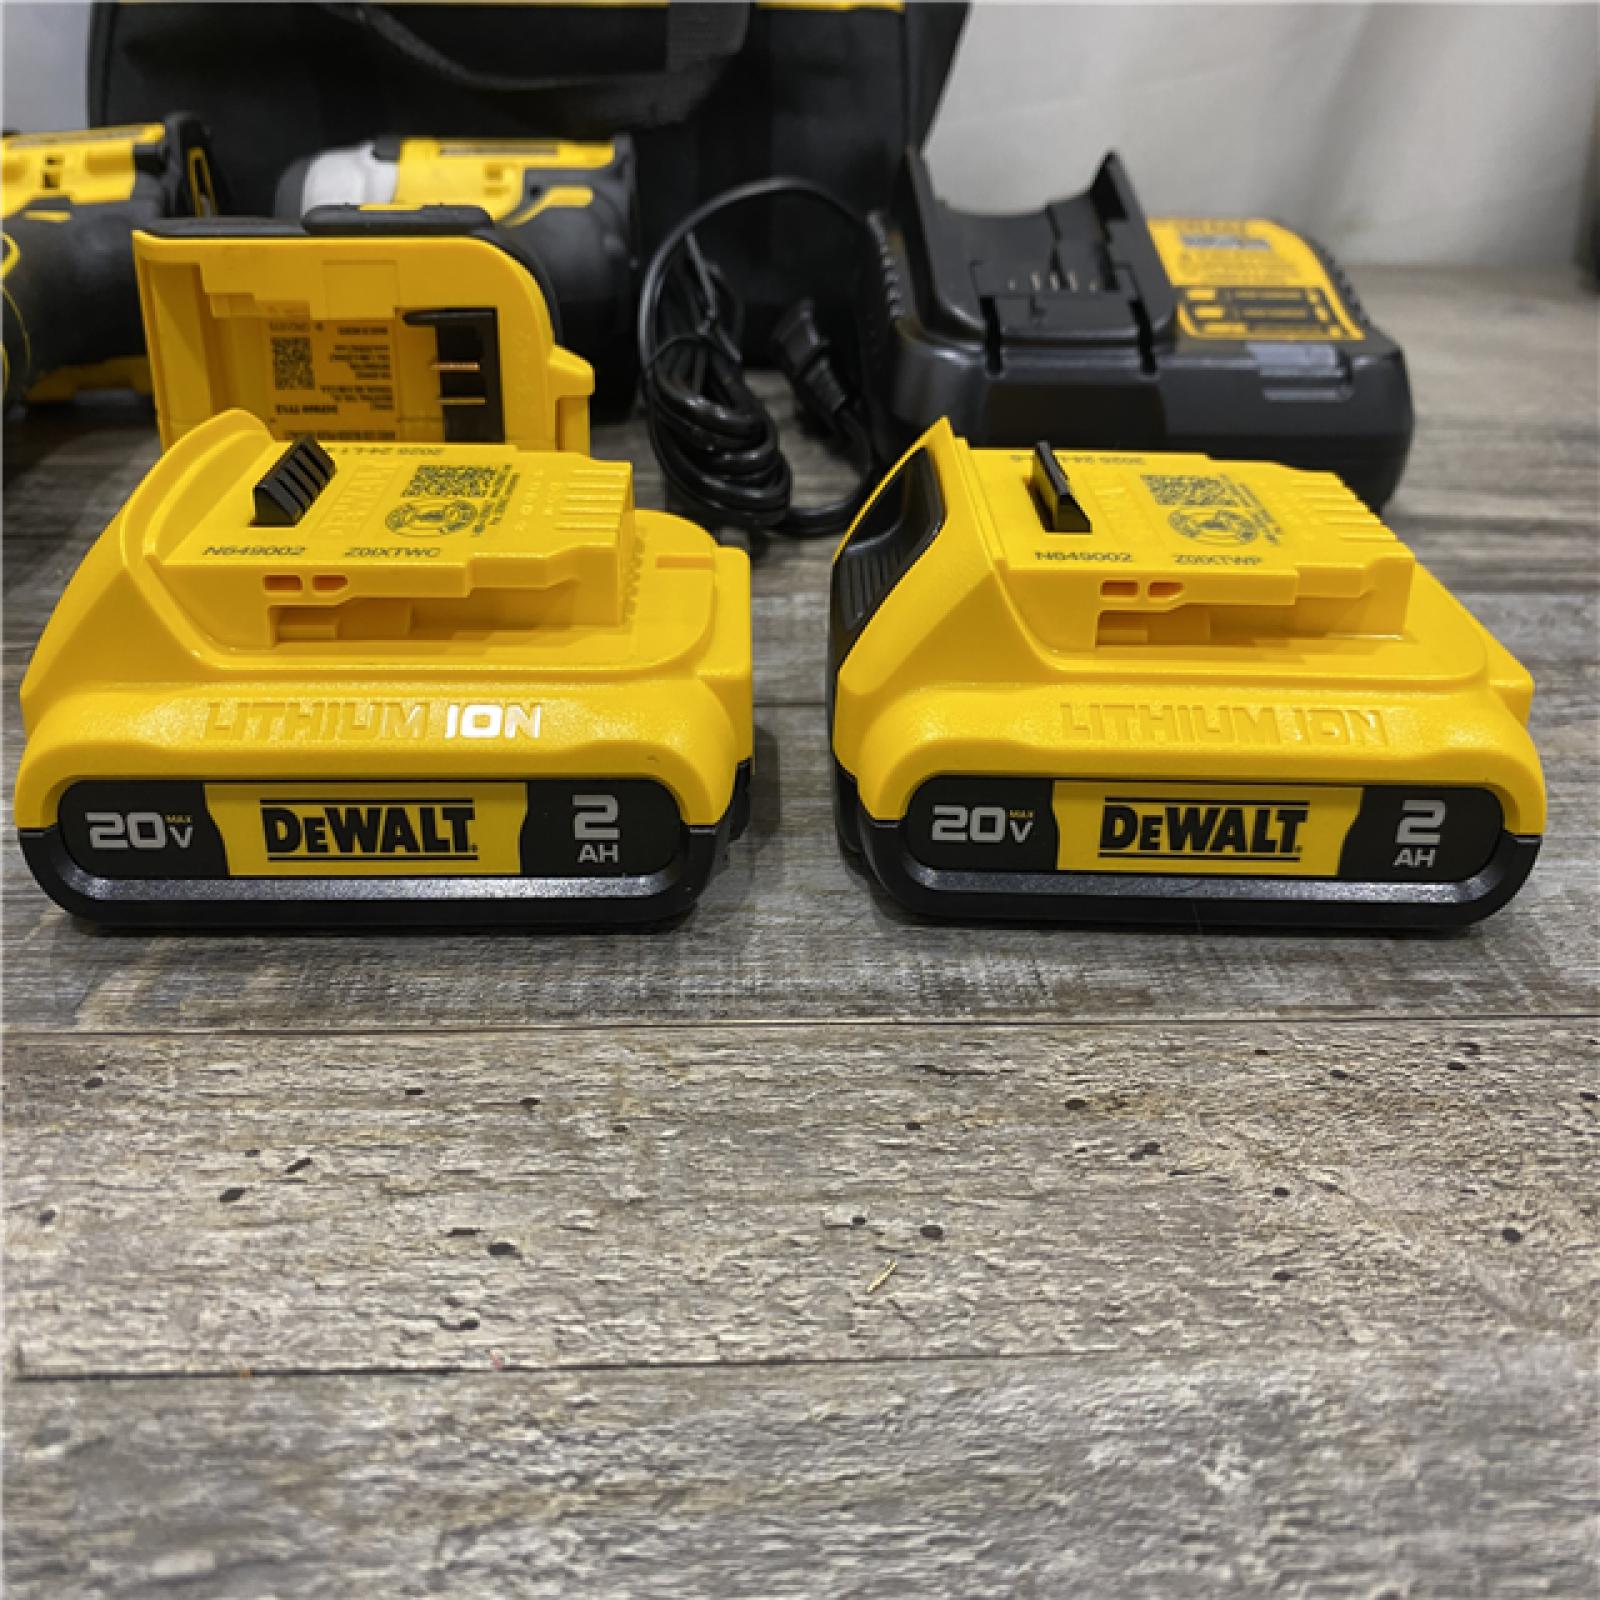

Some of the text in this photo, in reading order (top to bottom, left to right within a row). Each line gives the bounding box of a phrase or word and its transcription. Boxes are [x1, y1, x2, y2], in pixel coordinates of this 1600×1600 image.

[204, 702, 543, 740] LITHIUM ION
[1059, 703, 1389, 747] LITHIUM ION
[572, 794, 621, 841] 2
[1395, 799, 1447, 845] 2
[577, 844, 620, 864] AH
[1392, 847, 1437, 868] AH
